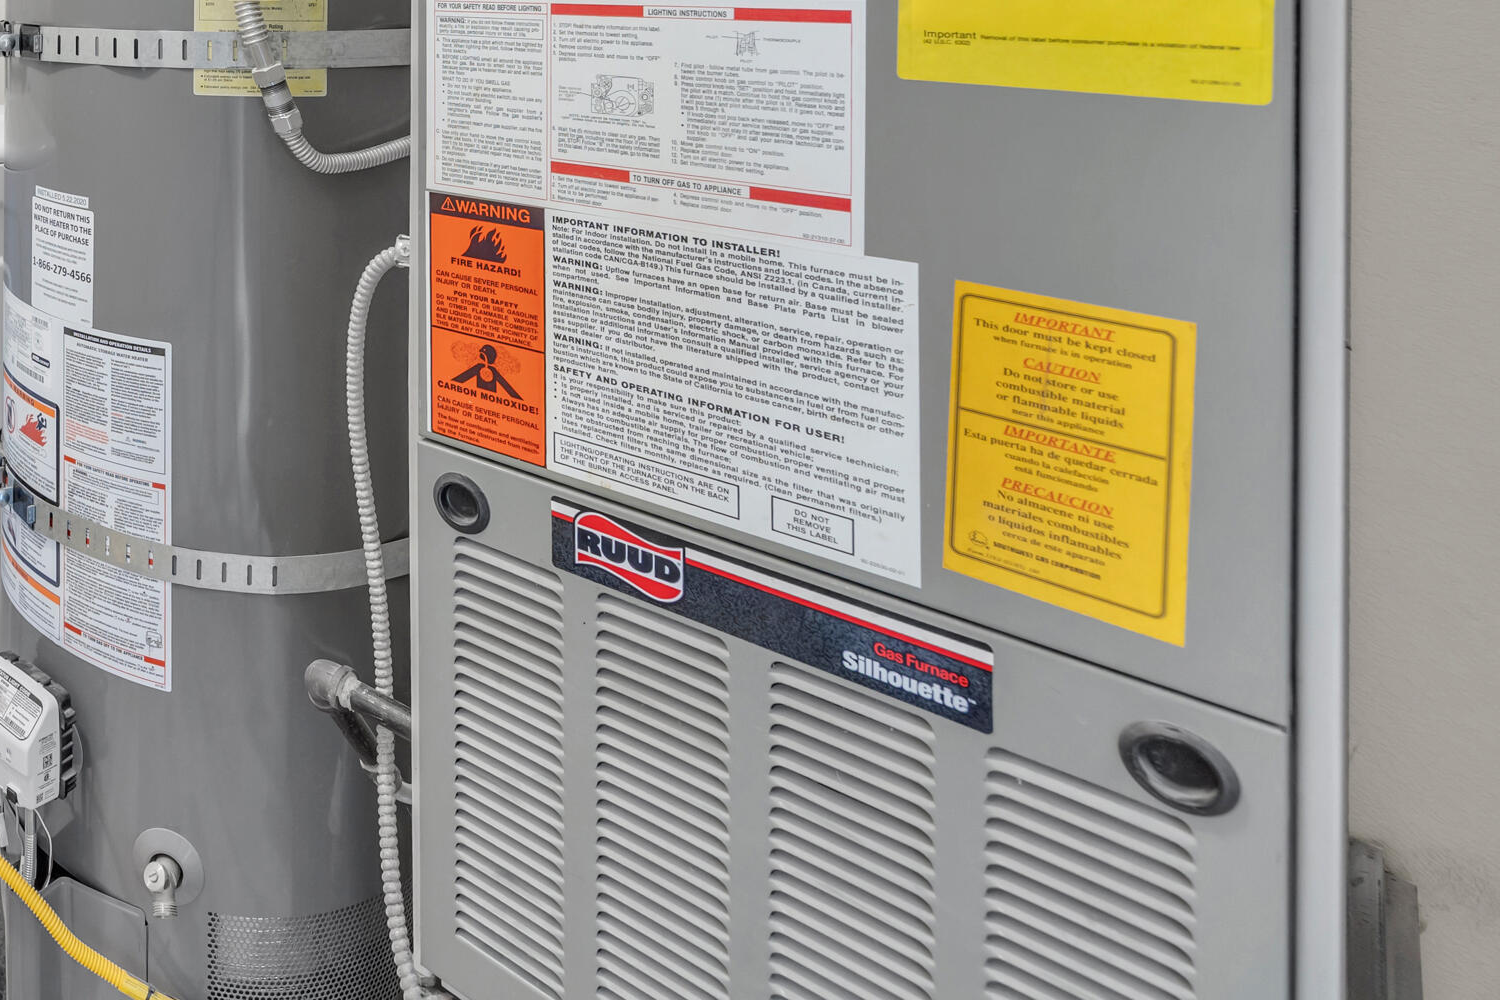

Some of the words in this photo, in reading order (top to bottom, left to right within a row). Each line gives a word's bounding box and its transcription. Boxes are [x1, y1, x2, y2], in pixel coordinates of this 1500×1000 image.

[646, 9, 678, 18] LIGHTING
[678, 10, 729, 19] INSTRUCTIONS
[923, 29, 977, 40] Important
[631, 174, 642, 185] TO
[642, 176, 660, 187] TURN
[660, 178, 675, 188] OFF
[675, 180, 691, 190] GAS
[691, 182, 702, 192] TO
[703, 184, 741, 195] APPLIANCE
[34, 202, 42, 211] DO
[42, 205, 52, 215] NOT
[53, 208, 75, 220] RETURN
[76, 213, 90, 224] THIS
[455, 200, 532, 222] WARNING
[34, 214, 49, 224] WATER
[49, 218, 69, 231] HEATER
[70, 224, 79, 232] TO
[80, 226, 92, 235] THE
[35, 225, 49, 235] PLACE
[50, 229, 57, 238] OF
[58, 232, 89, 246] PURCHASE
[552, 216, 609, 230] IMPORTANT
[613, 225, 688, 242] INFORMATION
[692, 237, 707, 246] TO
[712, 240, 780, 257] INSTALLER!
[33, 256, 92, 283] 1-866-279-4566
[451, 257, 472, 267] FIRE
[476, 262, 520, 277] HAZARD!
[552, 257, 602, 270] WARNING:
[436, 270, 449, 279] CAN
[450, 273, 471, 282] CAUSE
[473, 277, 499, 287] SEVERE
[500, 282, 538, 295] PERSONAL
[553, 282, 602, 295] WARNING:
[1013, 312, 1115, 341] IMPORTANT
[553, 334, 602, 349] WARNING:
[973, 317, 998, 330] This
[1002, 324, 1029, 336] door
[1032, 332, 1062, 344] must
[1066, 337, 1081, 346] be
[1084, 340, 1112, 353] kept
[1116, 348, 1156, 362] closed
[1023, 358, 1100, 383] CAUTION
[1003, 367, 1020, 378] Do
[1023, 374, 1043, 384] not
[1042, 375, 1076, 391] store
[1098, 391, 1118, 400] use
[437, 380, 476, 396] CARBON
[480, 392, 538, 414] MONOXIDE!
[553, 364, 591, 378] SAFETY
[596, 375, 617, 385] AND
[621, 381, 683, 402] OPERATING
[688, 398, 769, 424] INFORMATION
[775, 419, 800, 432] FOR
[805, 427, 844, 443] USER!
[995, 381, 1068, 402] combustible
[1072, 398, 1125, 415] material
[1012, 395, 1077, 417] flammable
[1081, 412, 1123, 428] liquids
[963, 427, 988, 441] Esta
[990, 437, 1026, 451] puerta
[1029, 445, 1043, 456] ha
[1047, 451, 1060, 460] de
[1063, 457, 1106, 471] quedar
[1109, 468, 1157, 485] cerrada
[1003, 425, 1115, 462] IMPORTANTE
[1000, 478, 1112, 518] PRECAUCION
[793, 517, 830, 532] REMOVE
[794, 509, 807, 517] DO
[811, 514, 829, 523] NOT
[787, 524, 806, 534] THIS
[809, 530, 838, 543] LABEL
[577, 526, 682, 585] RUUD
[873, 641, 904, 664] Gas
[905, 651, 970, 689] Furnace
